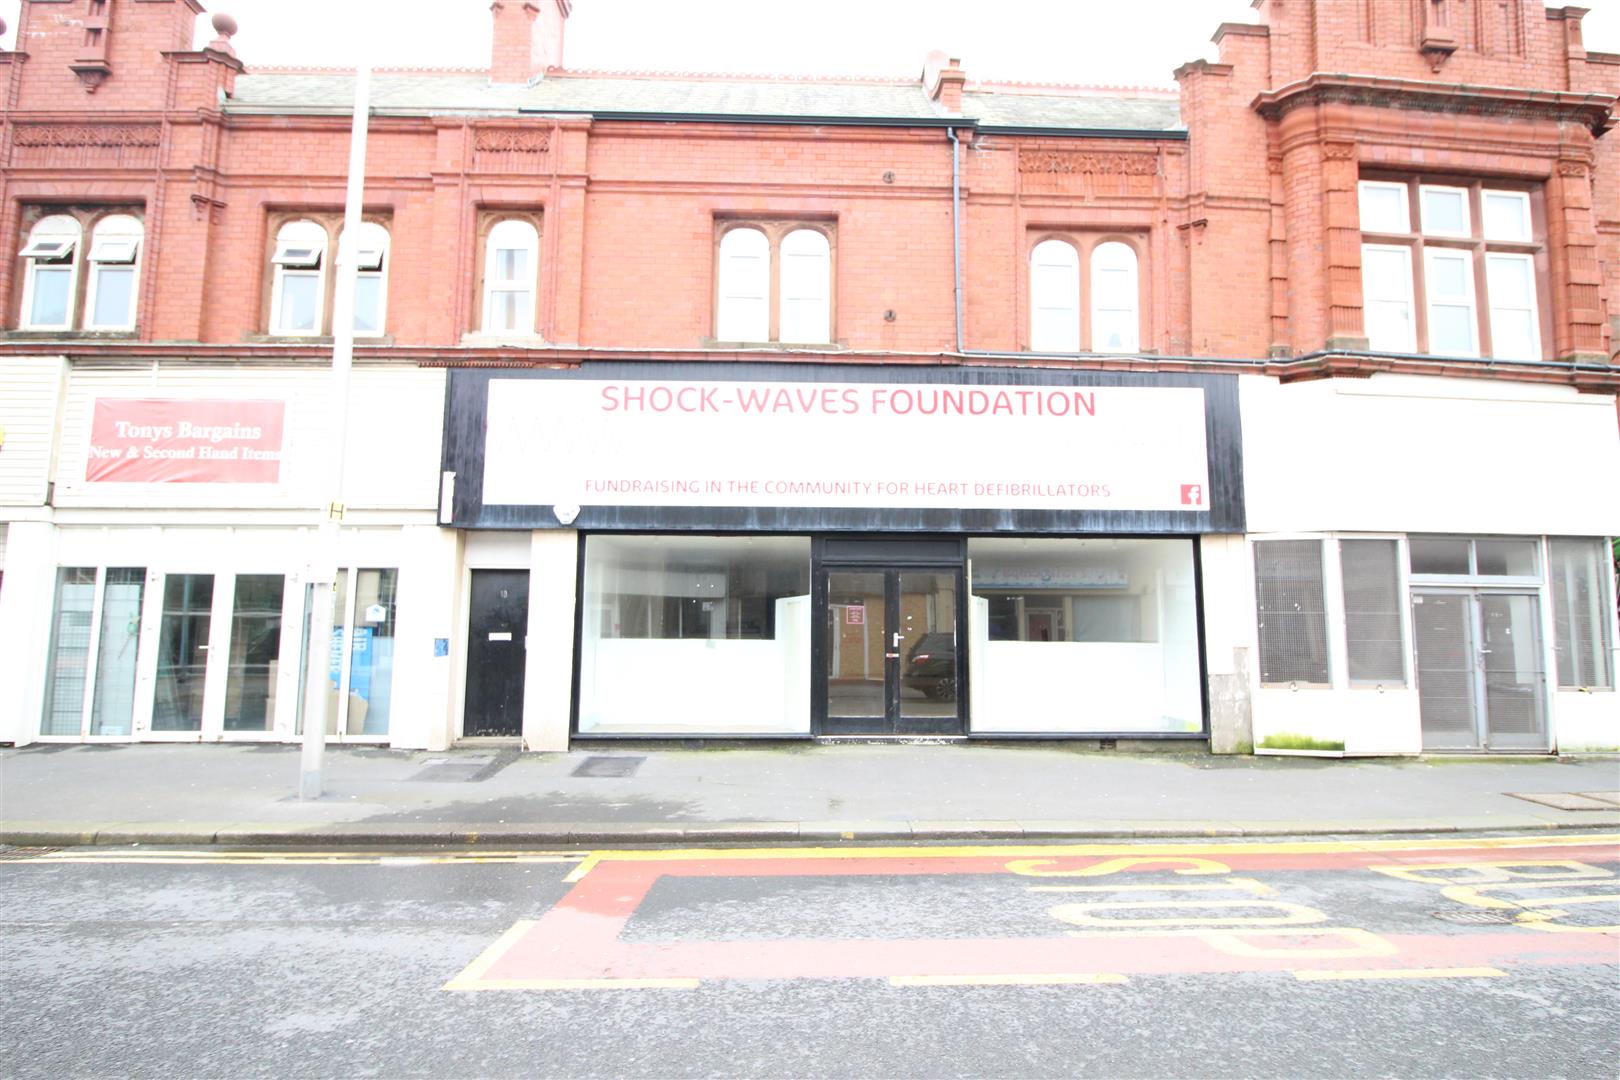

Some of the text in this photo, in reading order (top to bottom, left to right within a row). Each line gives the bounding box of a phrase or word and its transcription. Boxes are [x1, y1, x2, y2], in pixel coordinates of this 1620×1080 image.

[601, 385, 1096, 417] SHOCK-WAVES FOUNDATION
[115, 421, 262, 442] Tonys Bargains
[89, 446, 122, 459] New
[126, 446, 139, 459] &
[143, 446, 195, 460] Second
[199, 447, 237, 460] Hand
[585, 479, 1111, 498] FUNDRAISING IN THE COMMUNITY FOR HEART DEFIBRILLATORS
[330, 501, 344, 520] H
[1004, 856, 1400, 958] STOP
